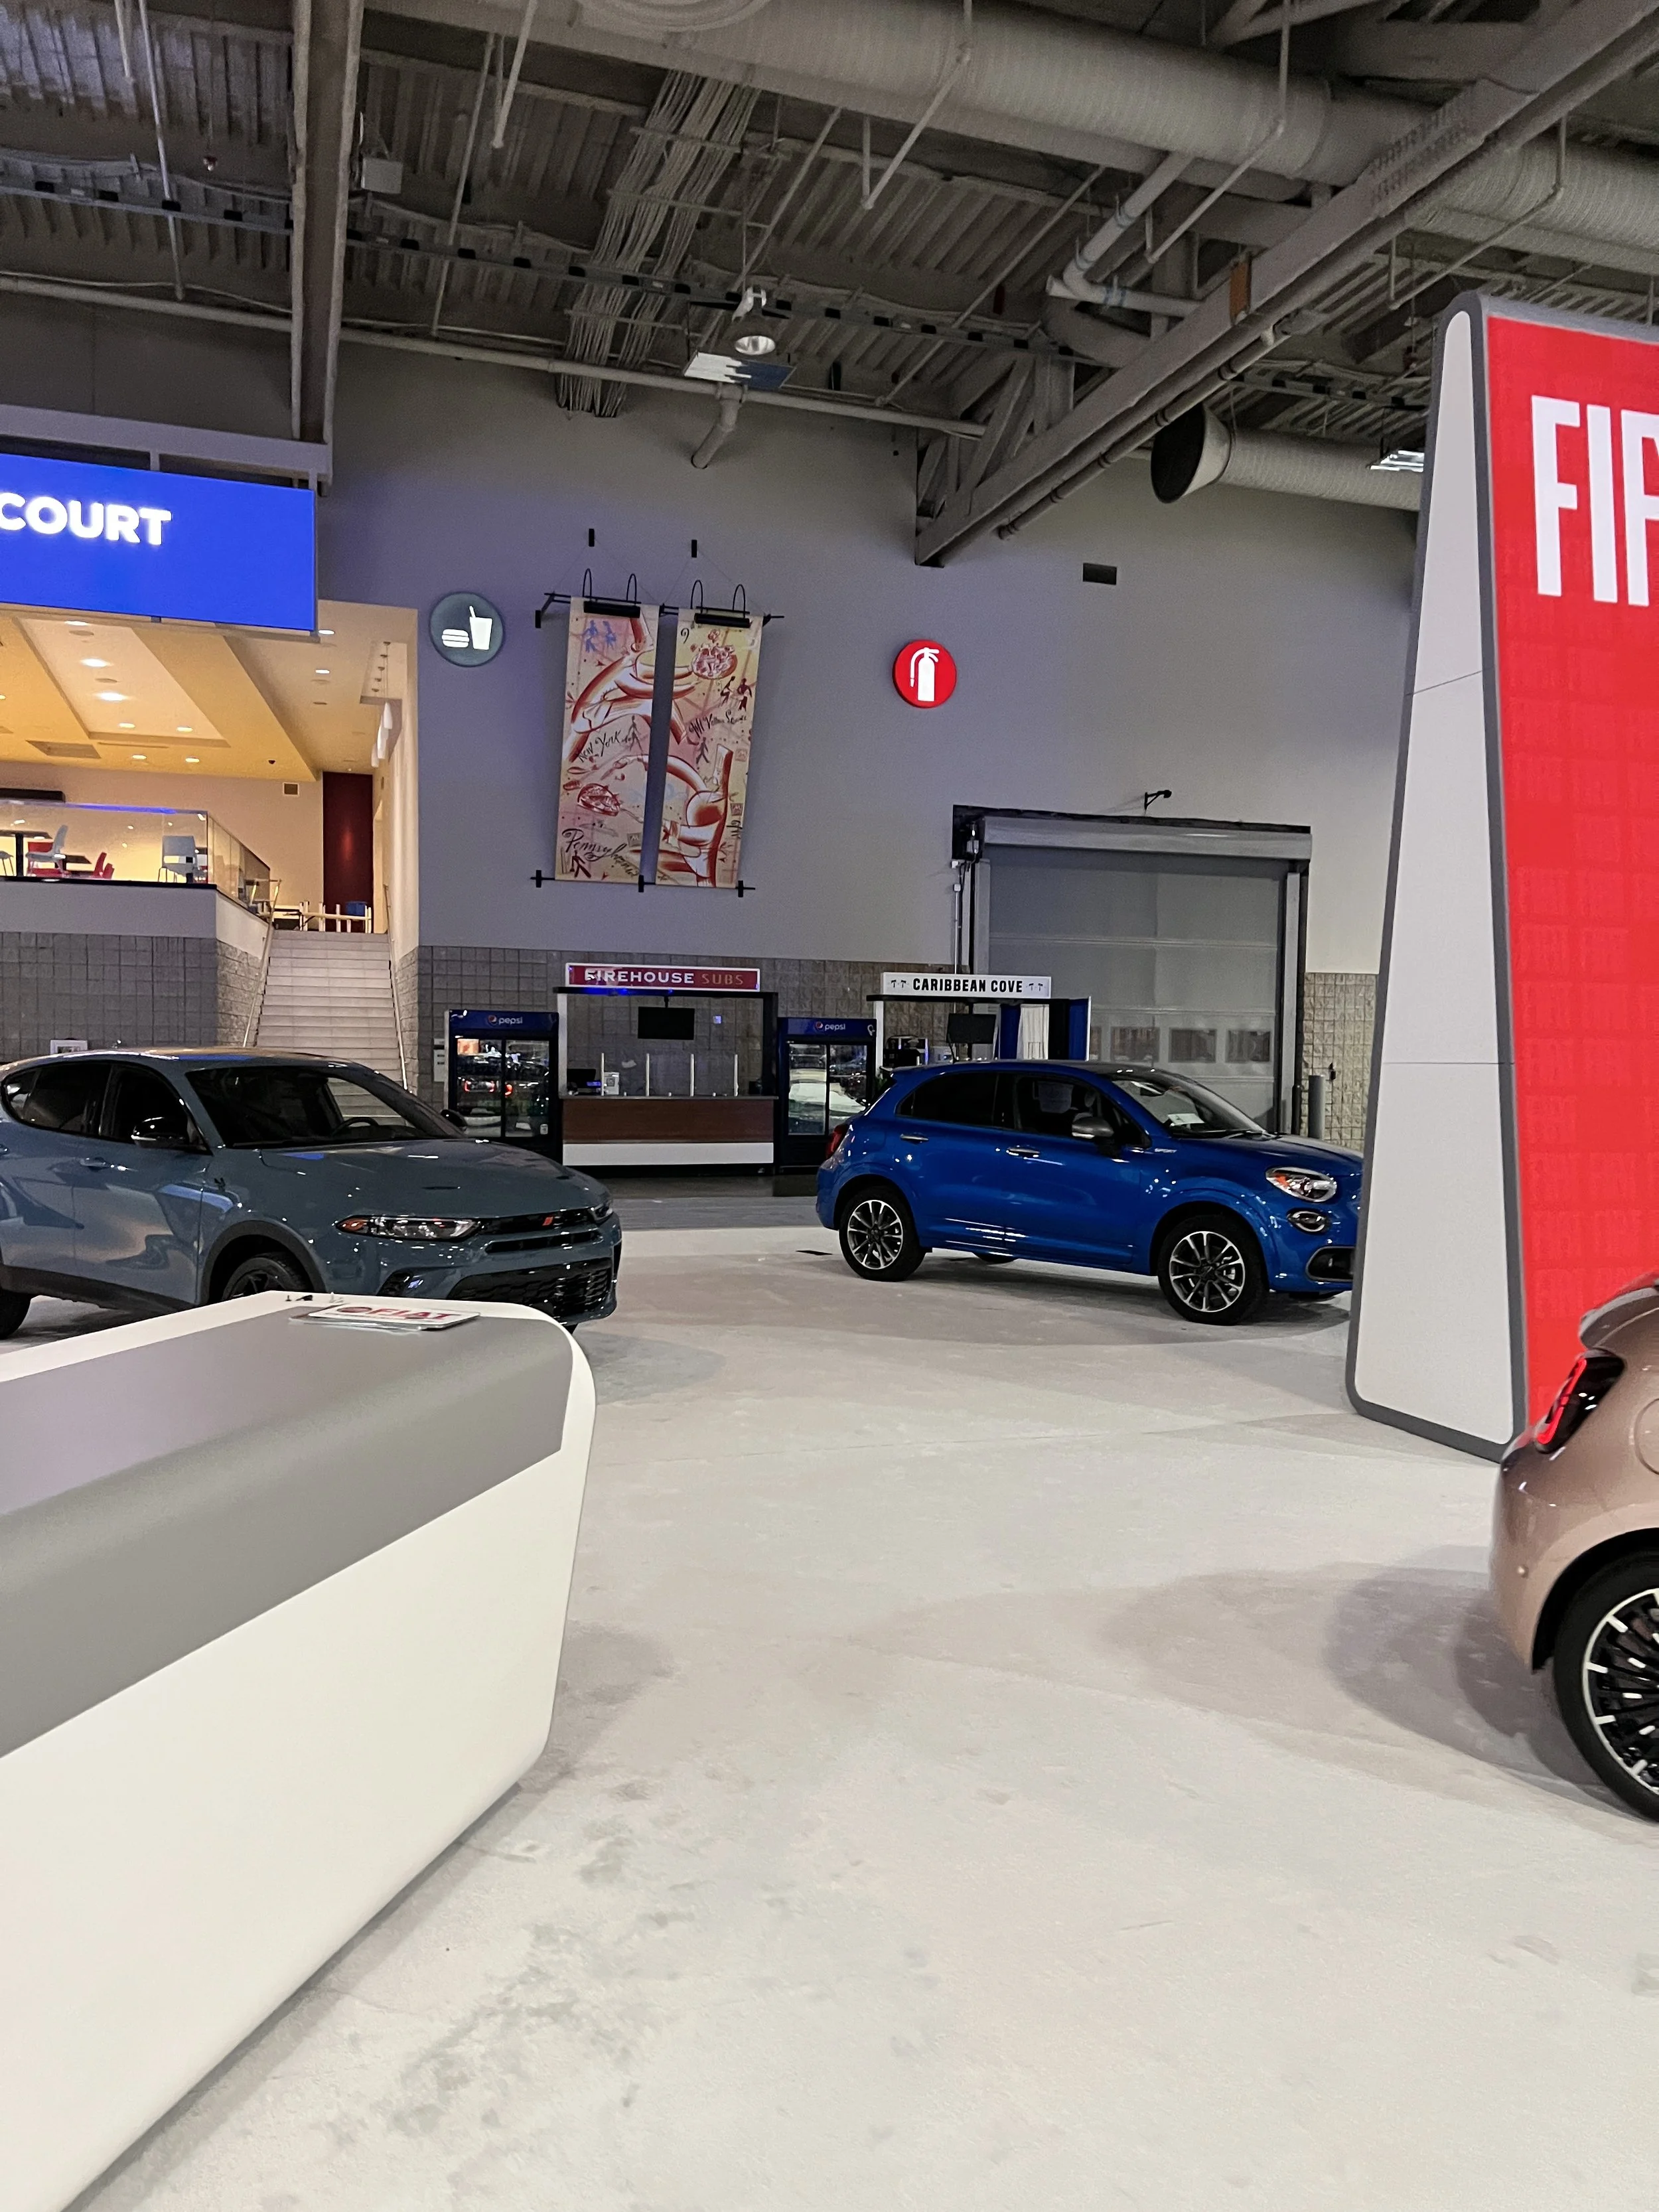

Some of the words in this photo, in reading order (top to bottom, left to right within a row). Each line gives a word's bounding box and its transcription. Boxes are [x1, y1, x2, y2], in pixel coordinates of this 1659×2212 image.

[0, 492, 172, 546] COURT
[584, 968, 695, 984] FIREHOUSE
[701, 973, 744, 986] SUBS
[912, 978, 986, 992] CARIBBEAN
[990, 980, 1023, 993] COVE
[498, 1016, 523, 1025] pepsi
[366, 1308, 462, 1320] FIAT
